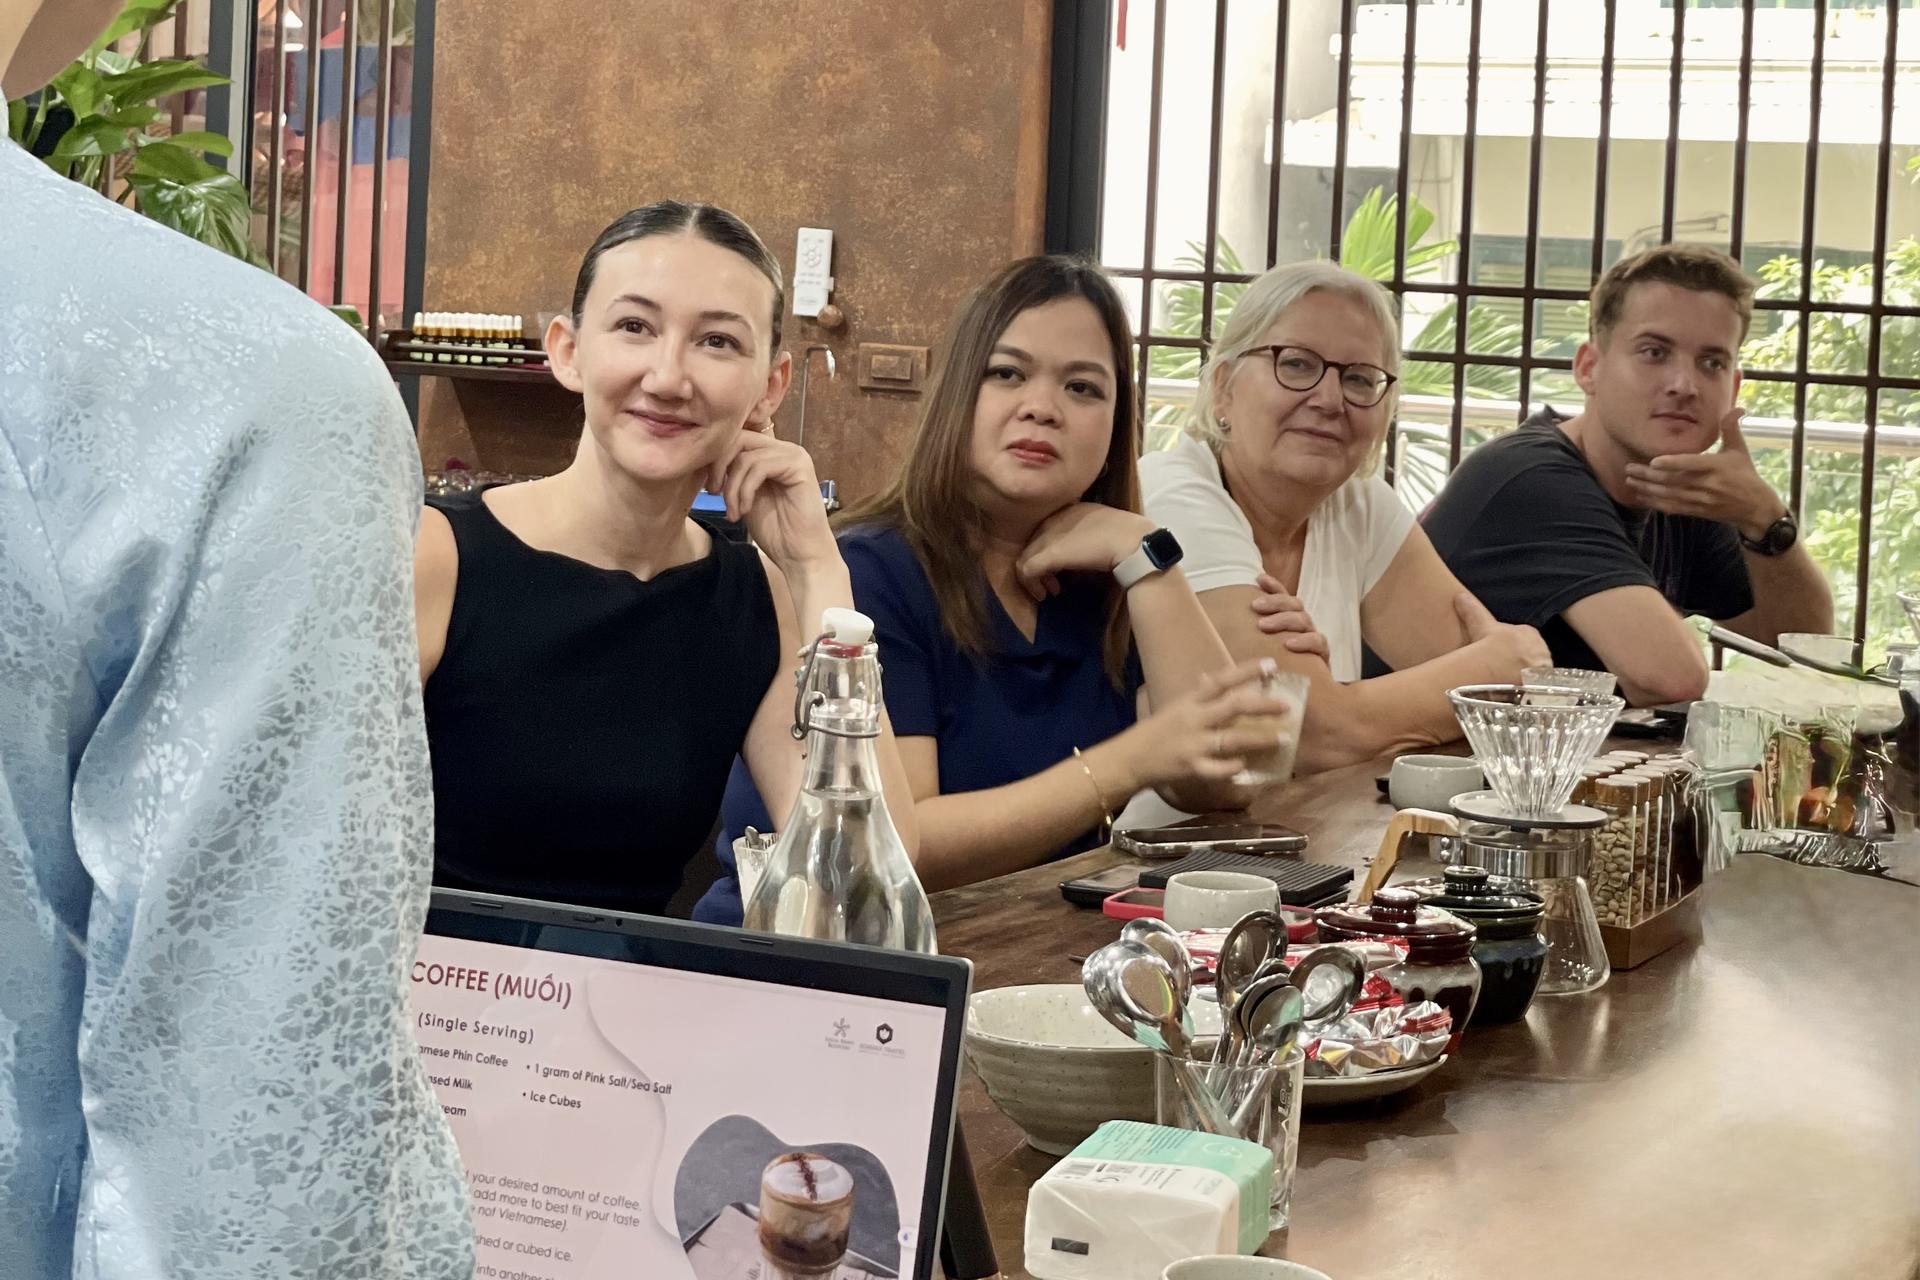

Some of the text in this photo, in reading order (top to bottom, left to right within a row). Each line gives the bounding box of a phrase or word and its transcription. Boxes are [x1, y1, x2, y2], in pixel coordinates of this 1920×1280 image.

[410, 961, 489, 992] COFFEE
[418, 1012, 534, 1044] (Single Serving)
[453, 1048, 473, 1062] Phin
[475, 1052, 509, 1067] Coffee
[452, 1077, 473, 1090] Milk
[535, 1063, 673, 1095] 1 gram of Pink Salt/Sea Salt
[530, 1090, 582, 1109] Ice Cubes
[472, 1173, 497, 1185] your
[498, 1176, 539, 1193] desired
[541, 1184, 585, 1200] amount
[588, 1191, 600, 1203] of
[473, 1189, 640, 1227] add more to best fit your taste
[478, 1206, 496, 1217] not
[502, 1241, 514, 1250] or
[516, 1243, 552, 1258] cubed
